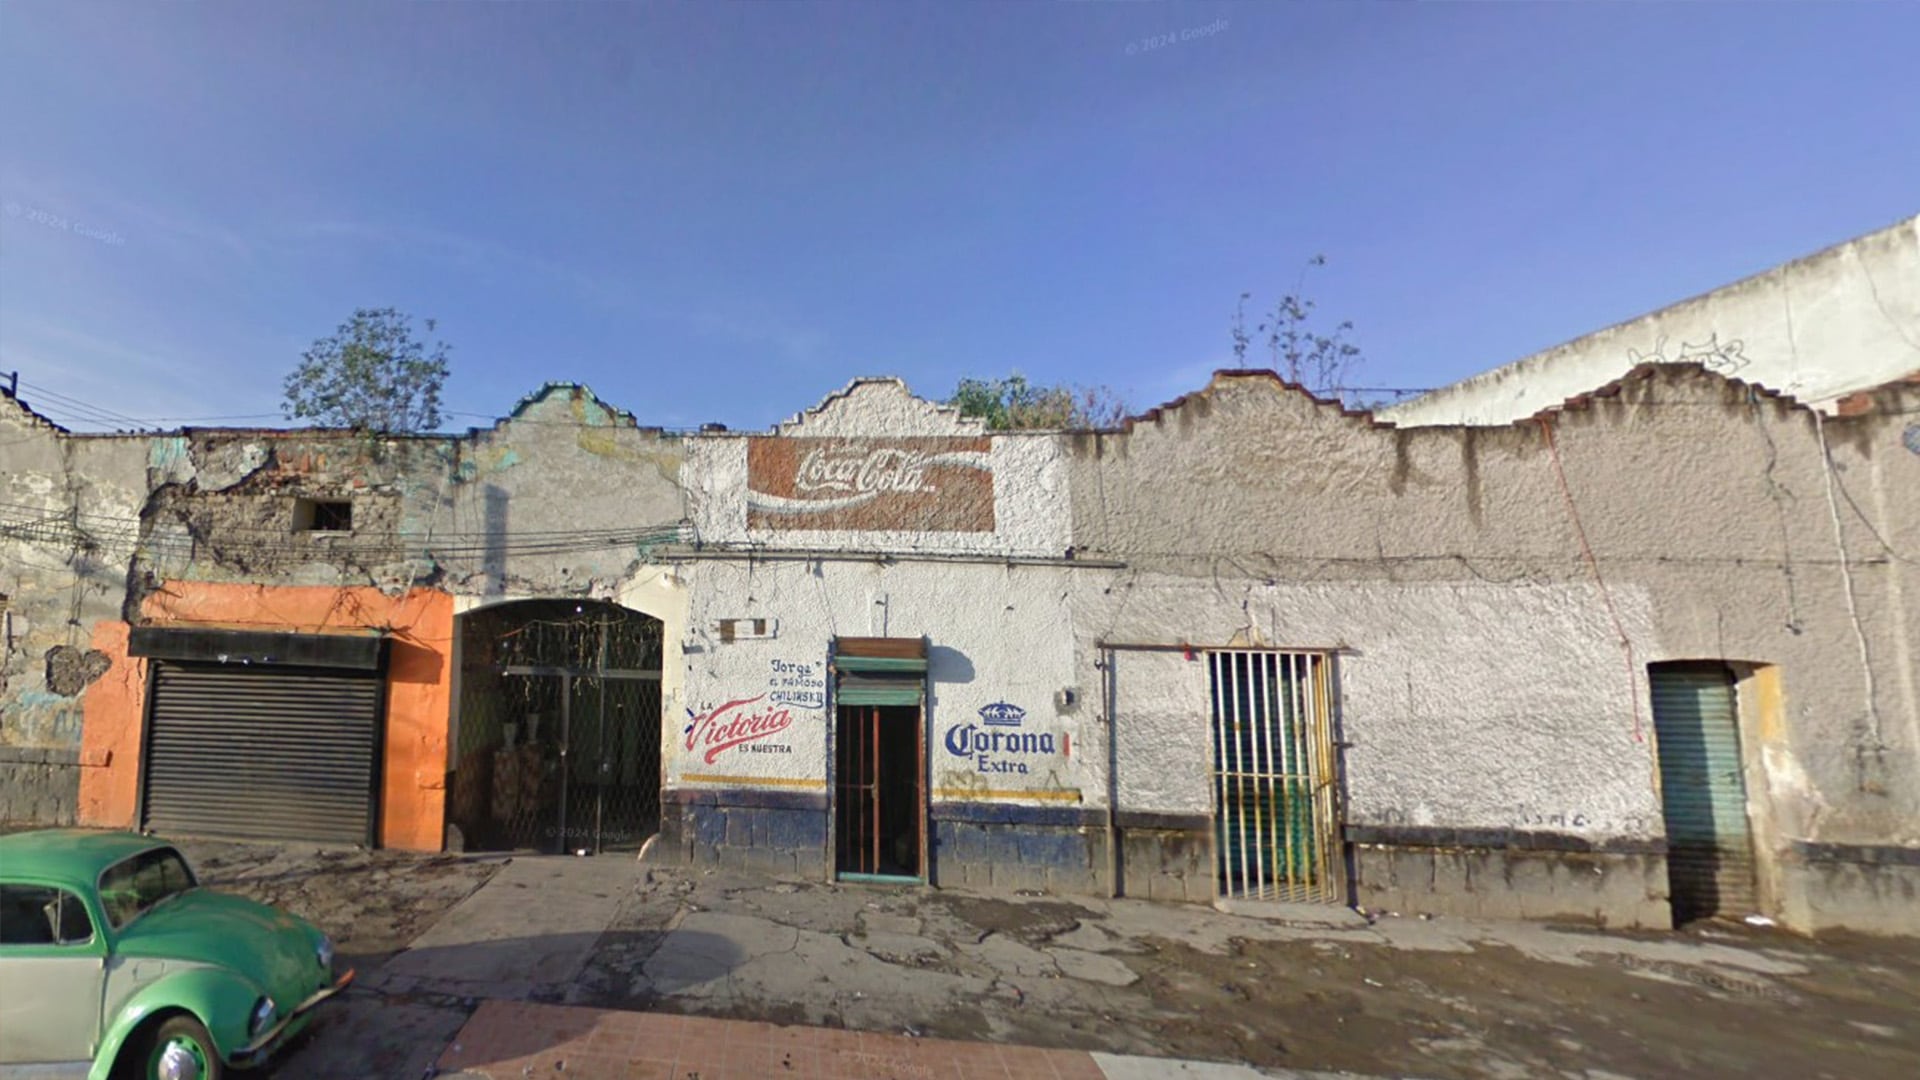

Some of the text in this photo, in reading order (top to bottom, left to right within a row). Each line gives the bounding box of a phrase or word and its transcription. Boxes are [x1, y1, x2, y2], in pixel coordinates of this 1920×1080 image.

[782, 678, 824, 688] FAMOSO
[700, 701, 714, 711] LA
[685, 692, 794, 764] Victoria
[739, 743, 792, 754] ES NUESTRA
[944, 723, 1056, 760] Corona
[977, 754, 1029, 775] Extra
